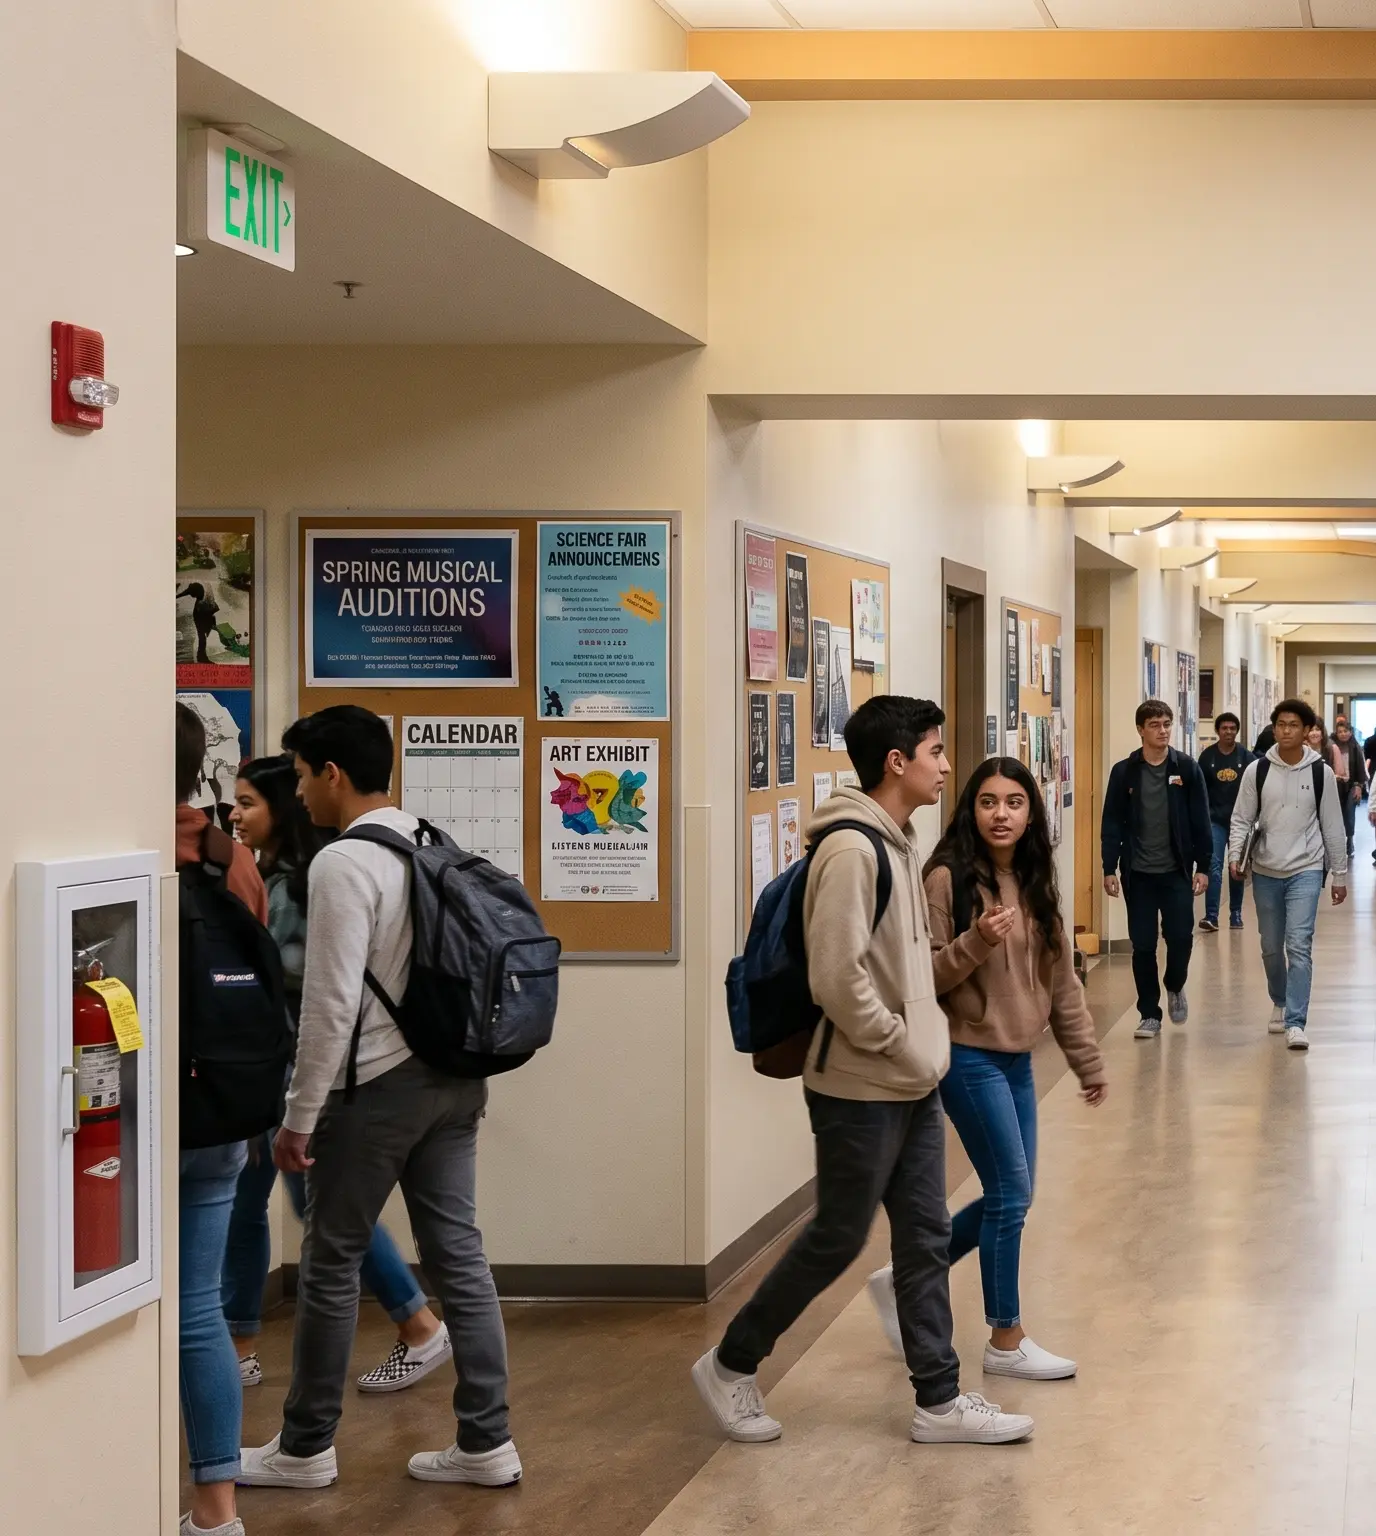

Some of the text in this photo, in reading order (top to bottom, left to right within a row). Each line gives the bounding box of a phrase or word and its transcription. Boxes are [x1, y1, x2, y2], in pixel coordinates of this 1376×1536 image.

[225, 146, 284, 254] EXIT
[556, 532, 647, 547] SCIENCE FAIR
[547, 551, 660, 566] ANNOUNCEMENS
[322, 560, 503, 583] SPRING MUSICAL
[337, 588, 486, 617] AUDITIONS
[407, 723, 518, 744] CALENDAR
[549, 745, 650, 762] ART EXHIBIT
